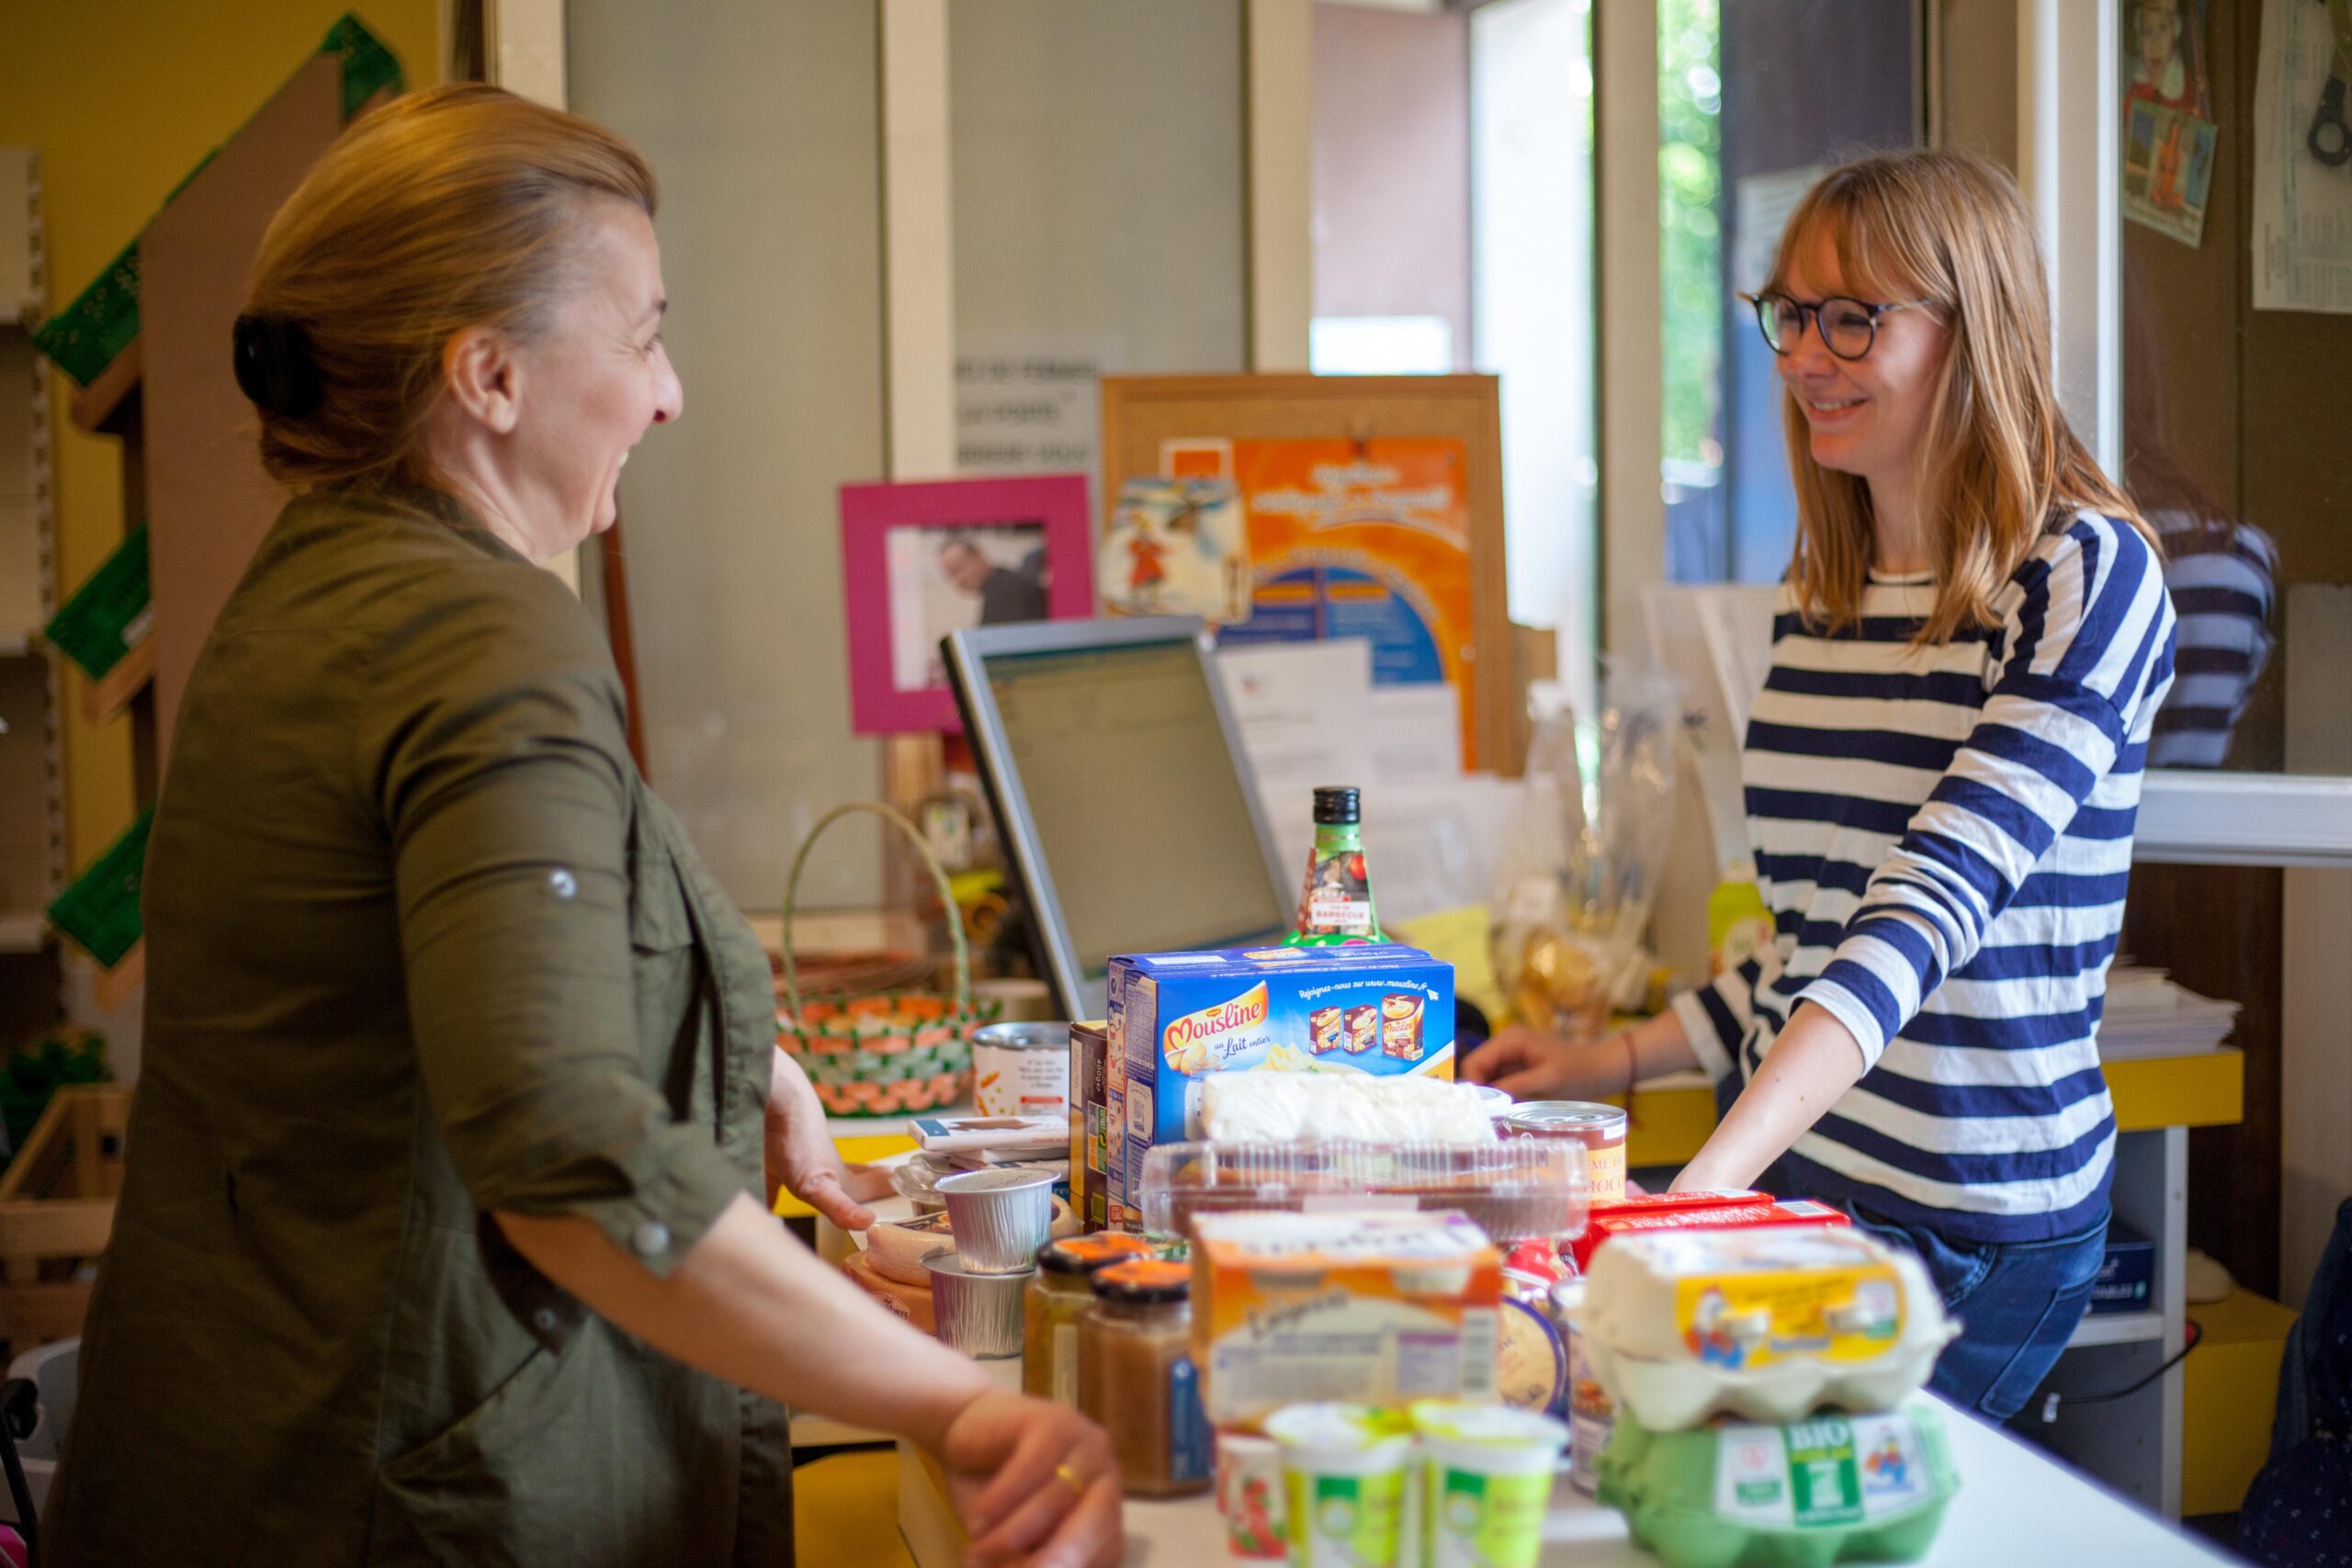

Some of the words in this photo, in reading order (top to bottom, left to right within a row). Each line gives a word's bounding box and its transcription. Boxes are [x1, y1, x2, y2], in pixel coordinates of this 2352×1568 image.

[1298, 982, 1351, 1000] Rejoignez-nous
[1352, 980, 1364, 988] sur
[1365, 979, 1428, 991] www.mousline.fr
[1167, 1002, 1261, 1050] Mousline
[1223, 1037, 1247, 1059] Lait
[1250, 1036, 1271, 1047] entier
